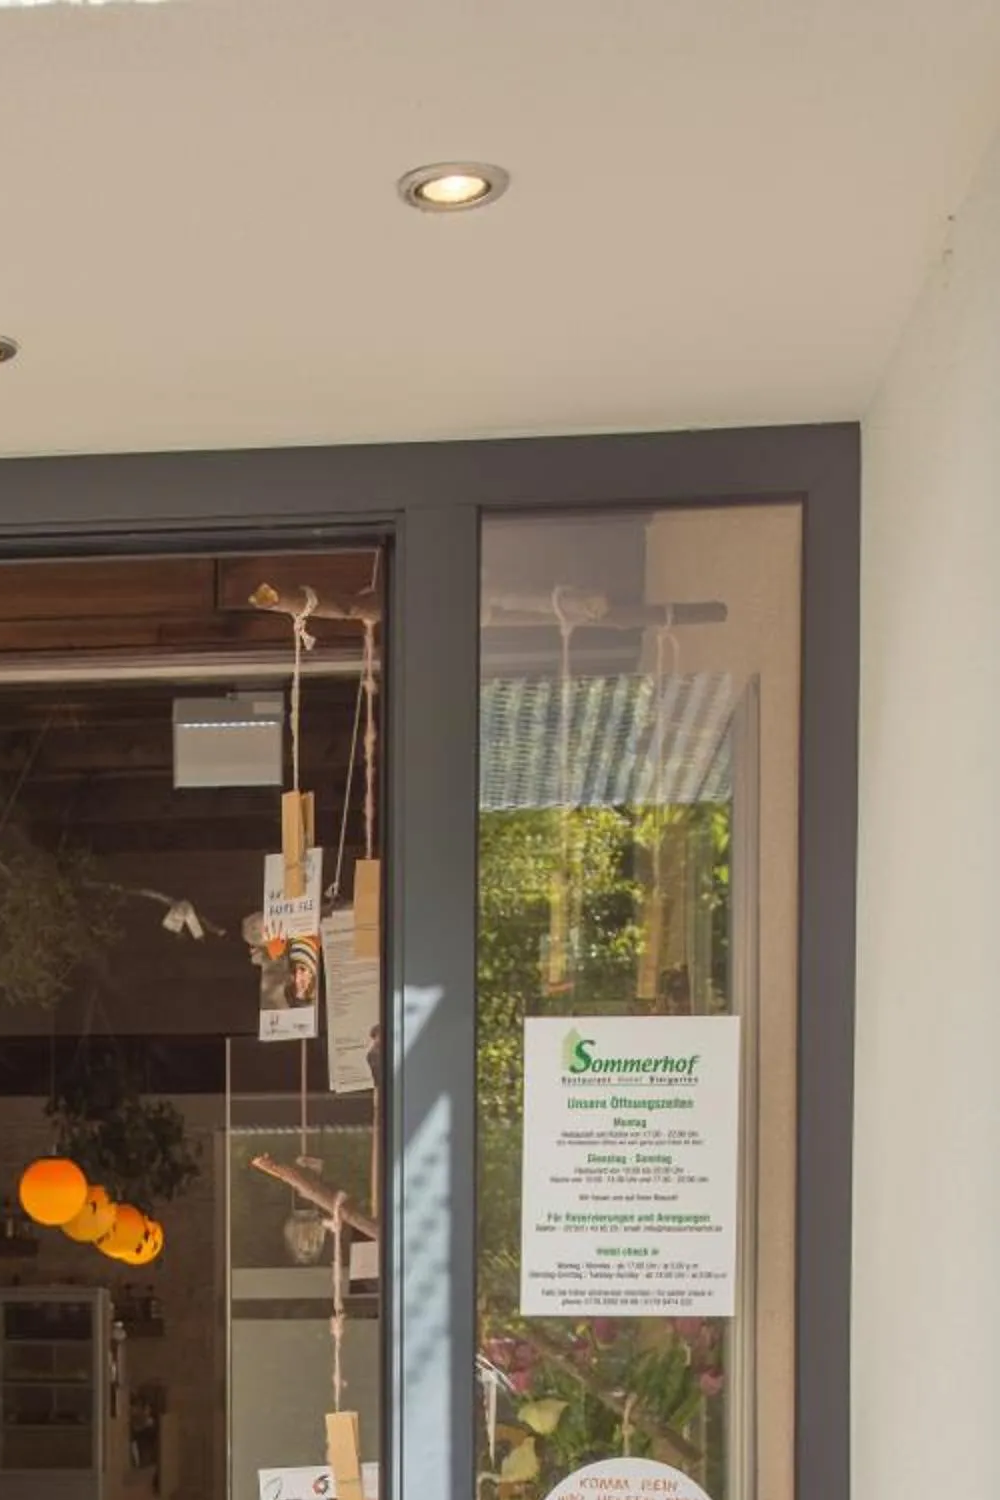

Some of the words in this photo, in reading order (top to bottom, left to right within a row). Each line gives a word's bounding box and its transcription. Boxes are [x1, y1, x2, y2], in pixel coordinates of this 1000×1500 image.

[569, 1039, 701, 1075] Sommerhof
[567, 1097, 607, 1109] Unsere
[579, 1477, 630, 1490] KOMM
[640, 1479, 678, 1493] REIN
